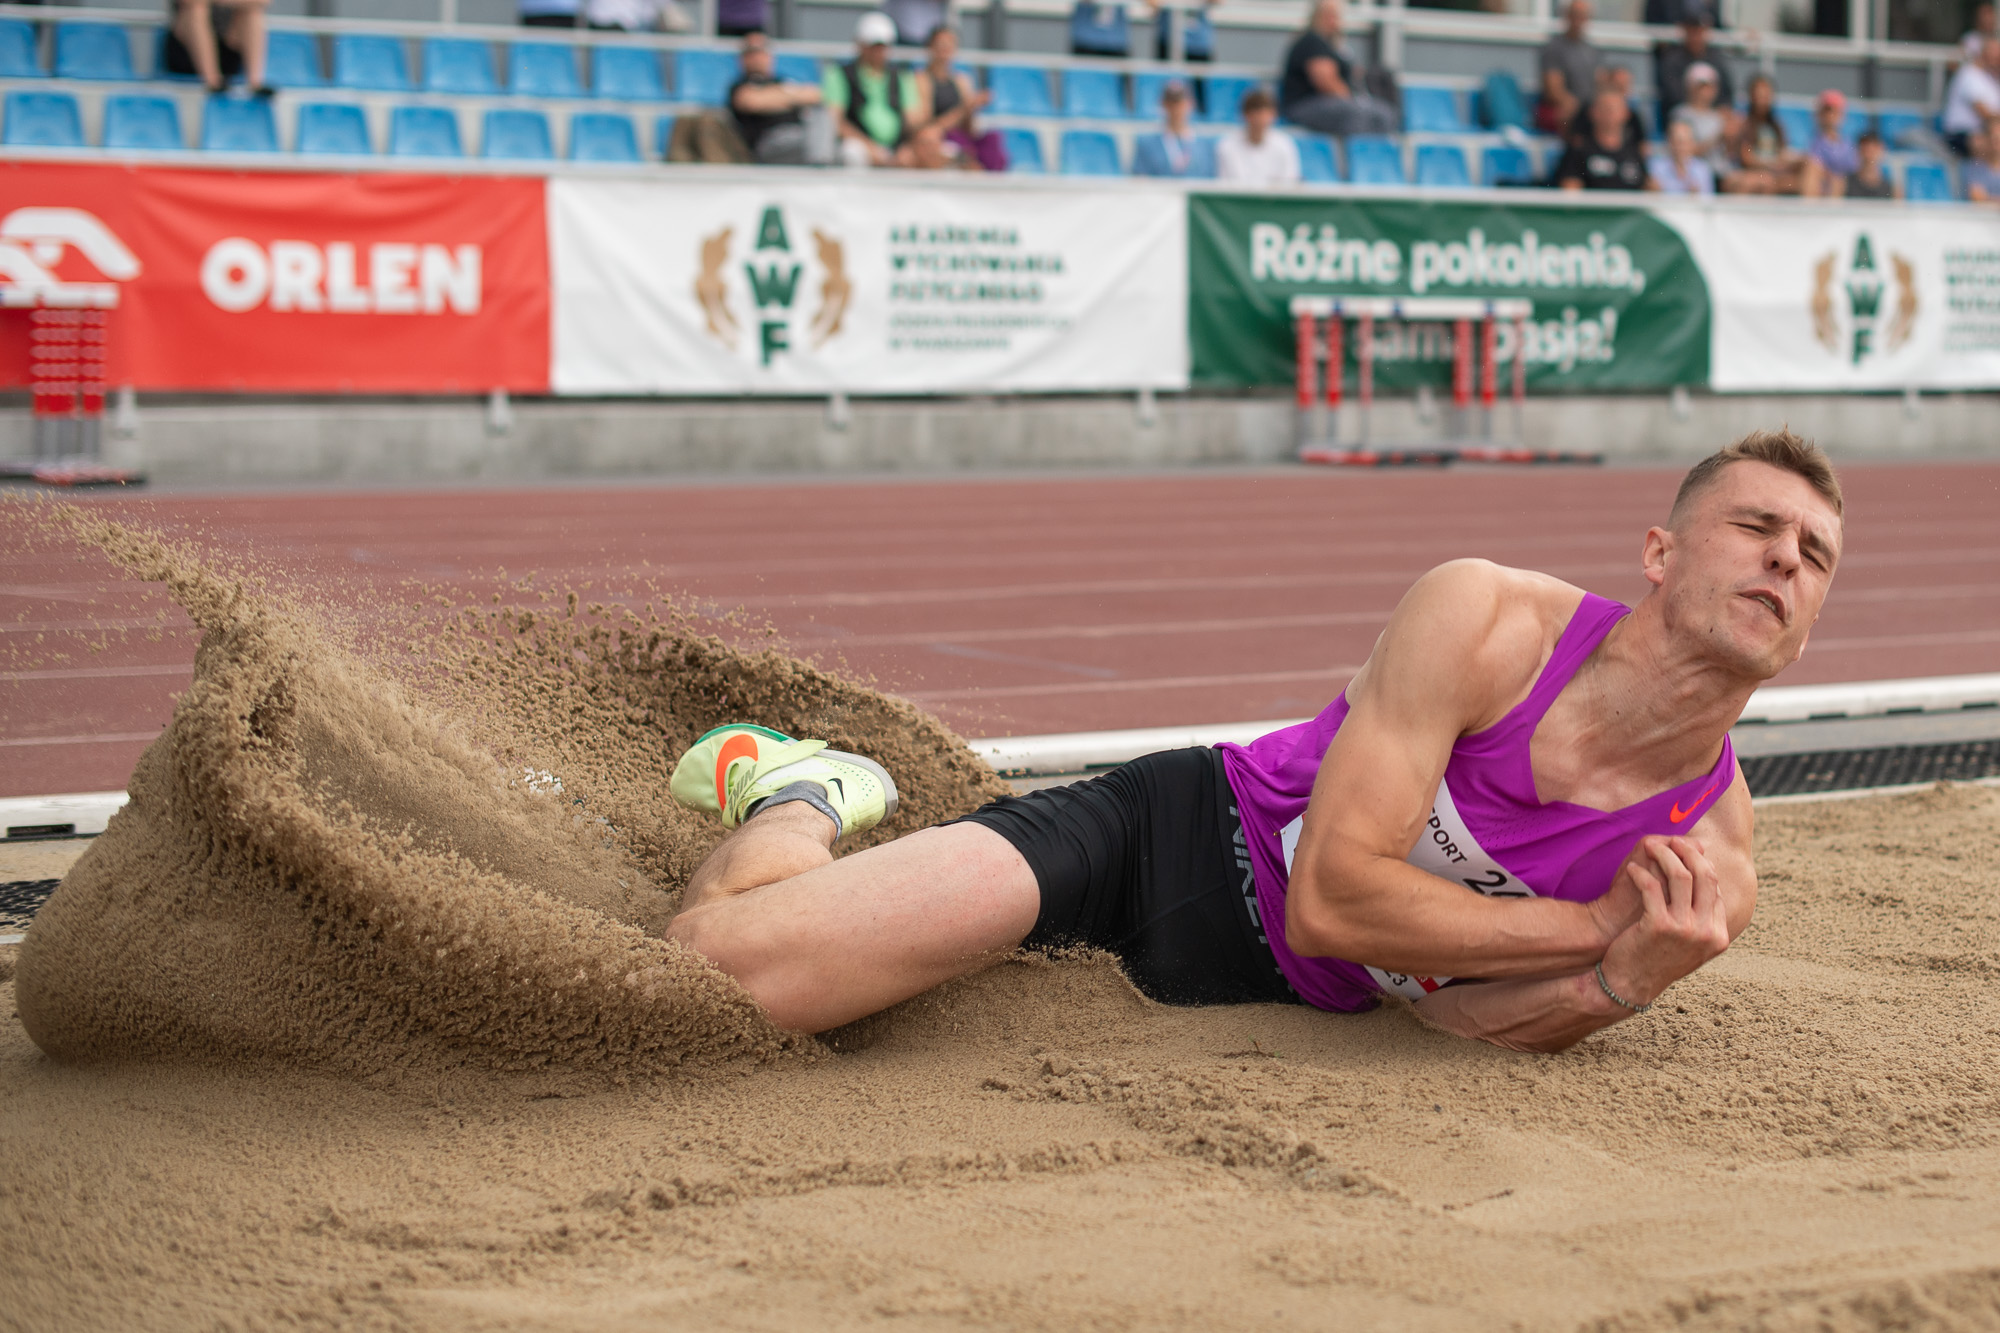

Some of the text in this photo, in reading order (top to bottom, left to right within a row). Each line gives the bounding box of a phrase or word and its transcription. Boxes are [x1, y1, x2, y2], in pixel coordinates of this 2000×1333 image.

[201, 237, 482, 315] ORLEN
[1250, 222, 1645, 295] Różne pokolenia,
